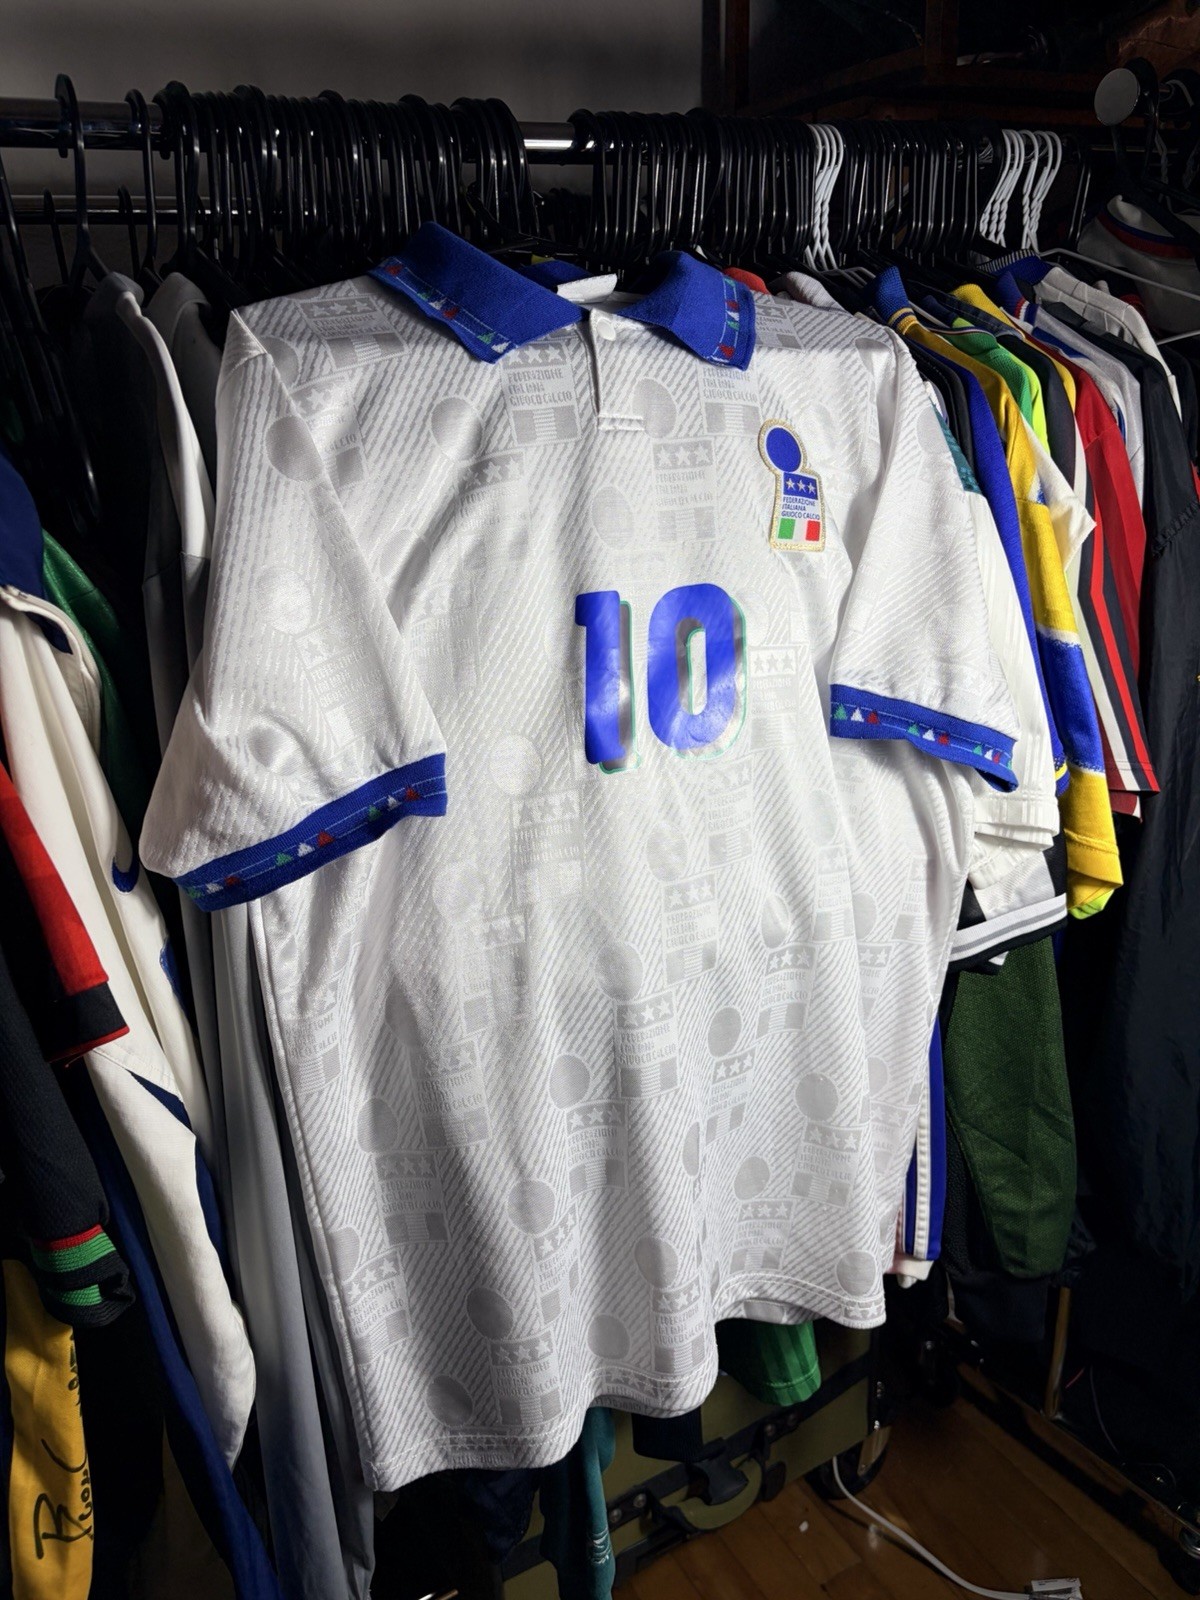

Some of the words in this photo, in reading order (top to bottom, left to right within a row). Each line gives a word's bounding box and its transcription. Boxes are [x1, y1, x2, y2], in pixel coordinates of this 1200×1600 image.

[507, 368, 562, 384] FEDERAZIONE
[508, 382, 545, 395] ITALIANA
[509, 394, 542, 407] GIUOCO
[543, 390, 573, 405] CALCIO
[781, 503, 807, 512] ITALIANA
[783, 497, 816, 507] FEDERAZIONE
[781, 511, 803, 519] GIUOCO
[803, 513, 821, 521] CALCIO
[574, 582, 747, 775] 10
